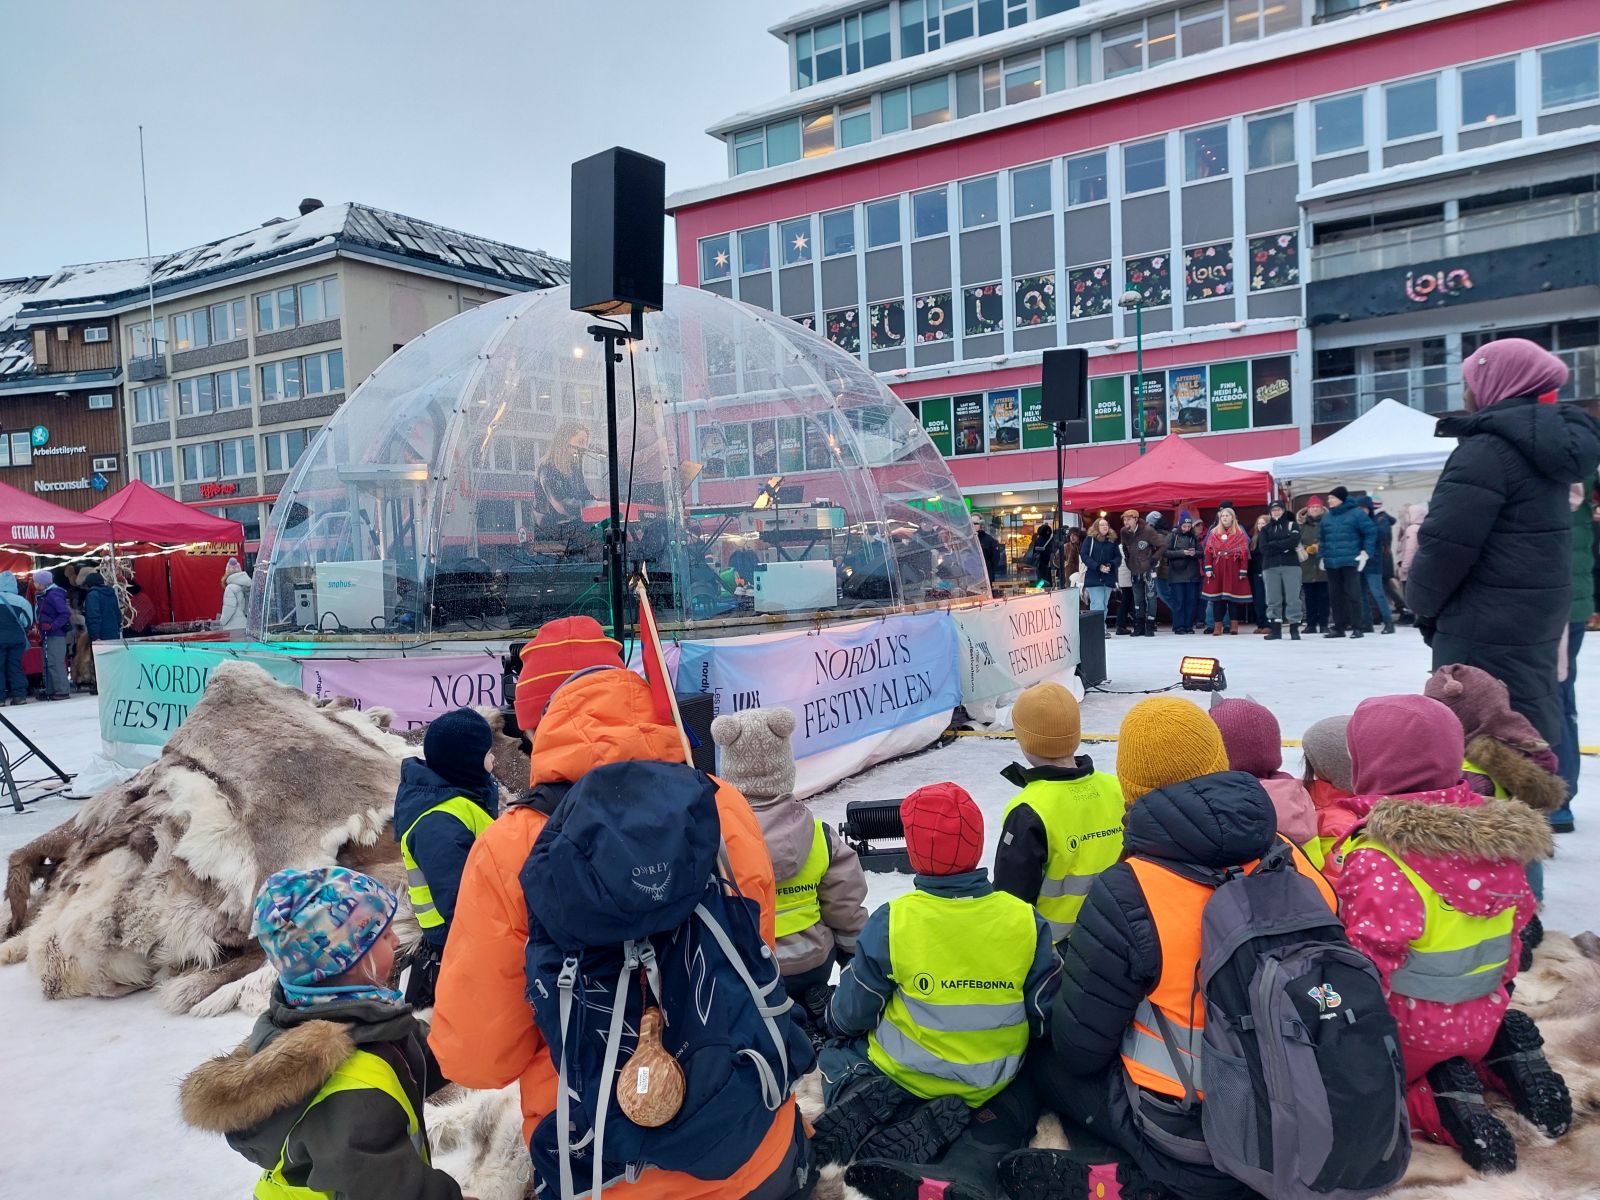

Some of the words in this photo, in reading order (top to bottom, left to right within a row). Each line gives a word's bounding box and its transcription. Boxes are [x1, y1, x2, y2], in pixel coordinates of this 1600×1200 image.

[1213, 388, 1232, 396] HEIDI
[1233, 386, 1243, 394] PÅ
[1211, 393, 1248, 403] FACEBOOK
[1094, 407, 1112, 415] BORD
[1112, 405, 1122, 413] PÅ
[940, 423, 949, 431] PÅ
[33, 445, 87, 456] Arbeidstilsynet
[34, 477, 91, 492] Norconsult
[40, 525, 55, 540] A/S
[1009, 604, 1062, 640] NORDLYS
[814, 634, 911, 685] NORDLYS
[1008, 634, 1072, 677] FESTIVALEN
[803, 671, 932, 738] FESTIVALEN
[941, 979, 1015, 990] KAFFEBØNNA
